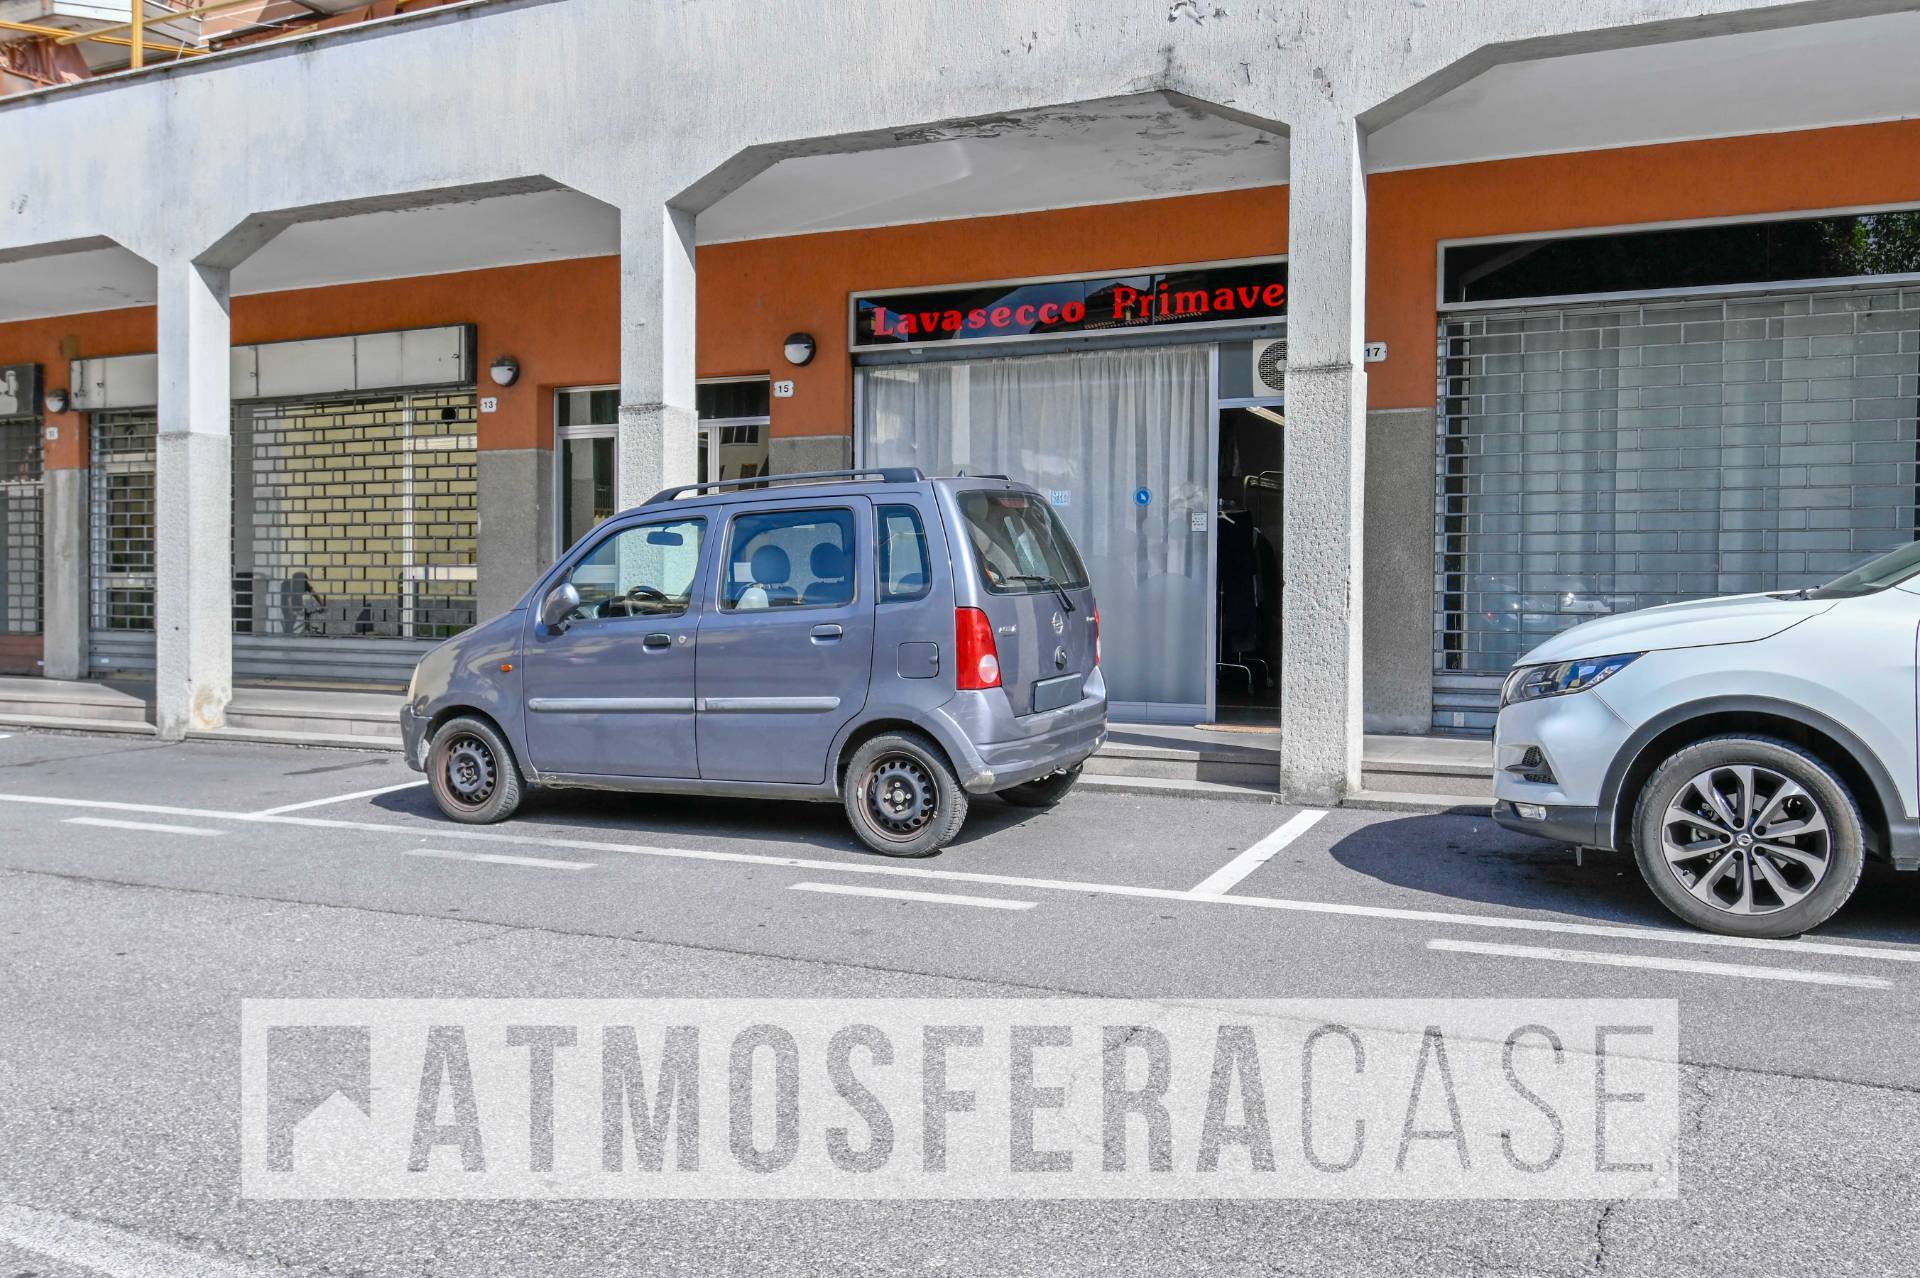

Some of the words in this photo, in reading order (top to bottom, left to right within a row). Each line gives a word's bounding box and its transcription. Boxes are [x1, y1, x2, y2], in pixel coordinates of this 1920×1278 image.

[870, 300, 1085, 336] Lavasecco
[1113, 283, 1285, 319] Primave
[1365, 347, 1381, 357] 17
